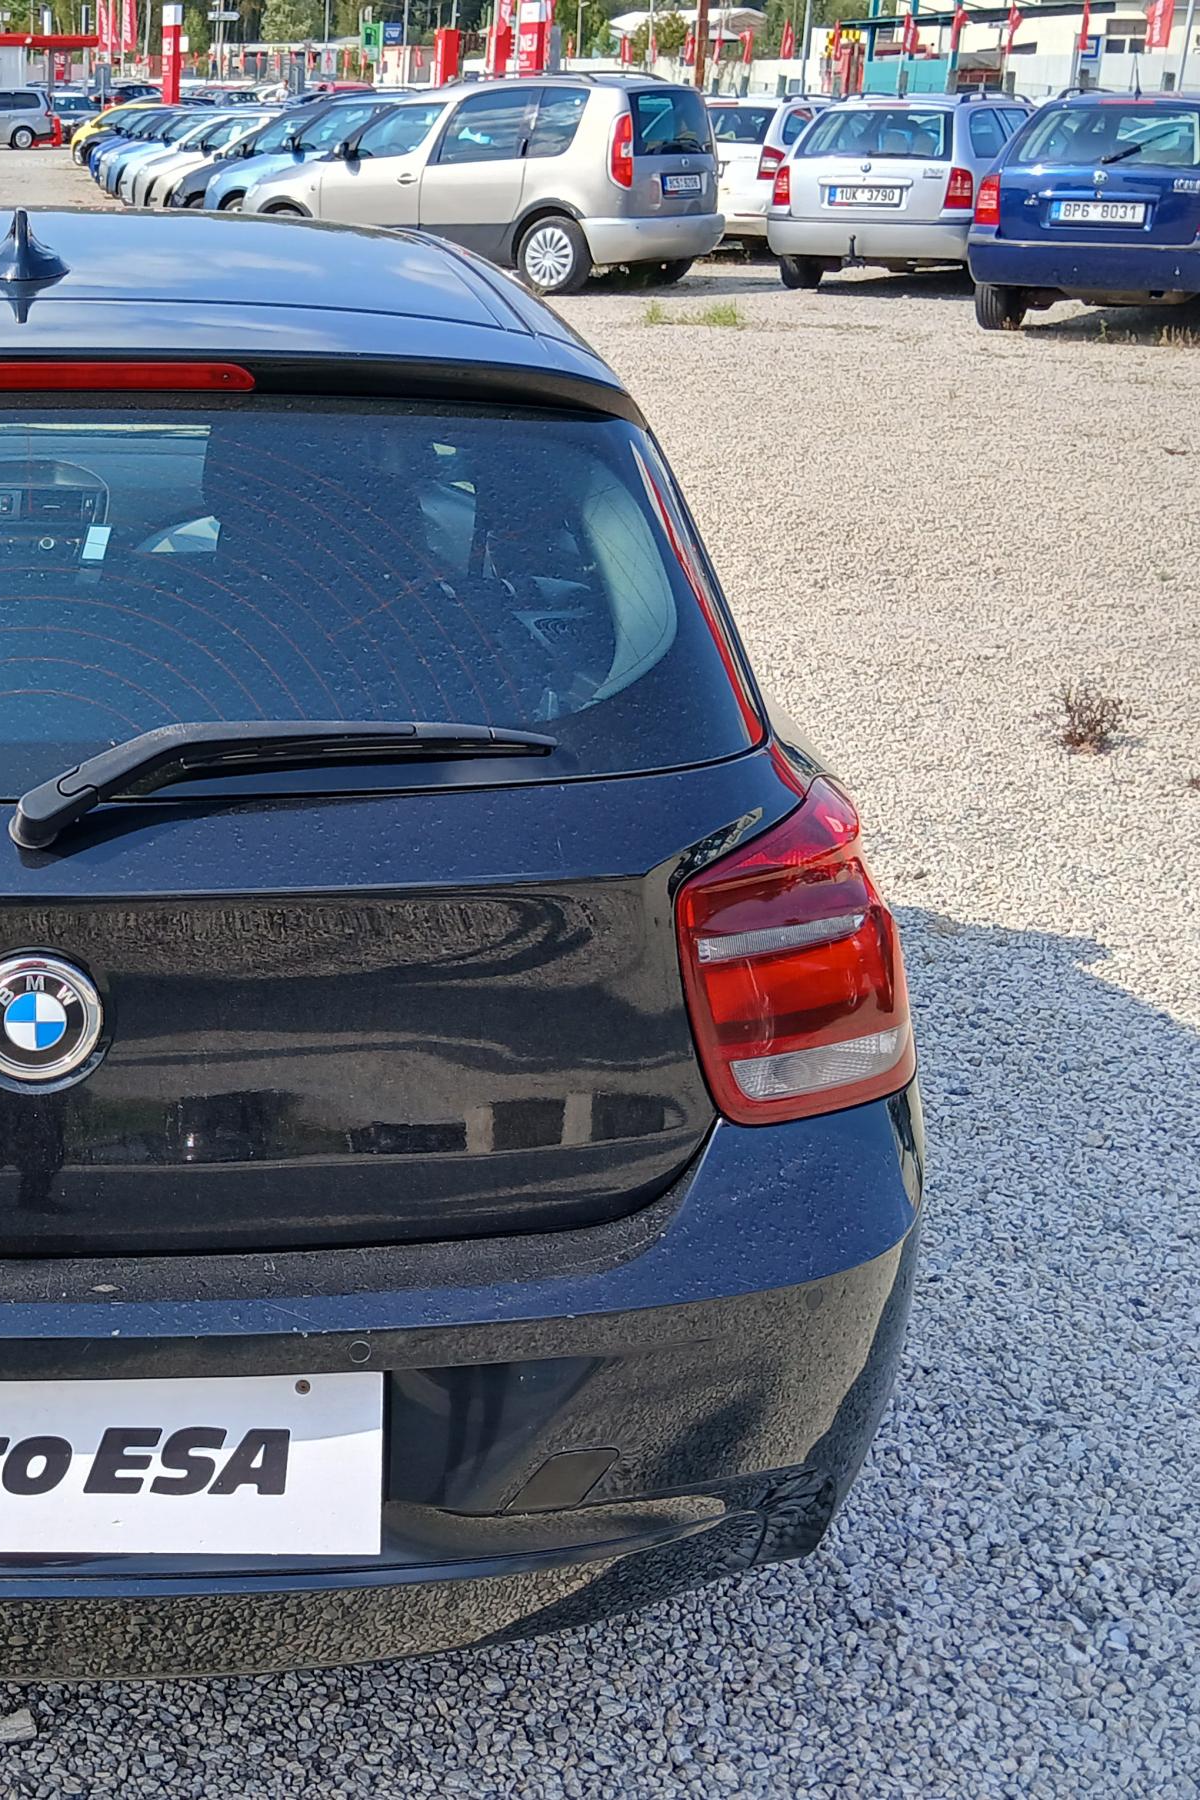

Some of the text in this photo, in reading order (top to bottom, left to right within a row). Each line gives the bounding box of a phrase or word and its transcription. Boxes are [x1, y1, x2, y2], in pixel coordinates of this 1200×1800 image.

[839, 188, 895, 202] 1UK 3790
[1063, 202, 1090, 218] 8P6
[1100, 203, 1137, 219] 8031
[83, 1427, 292, 1496] ESA
